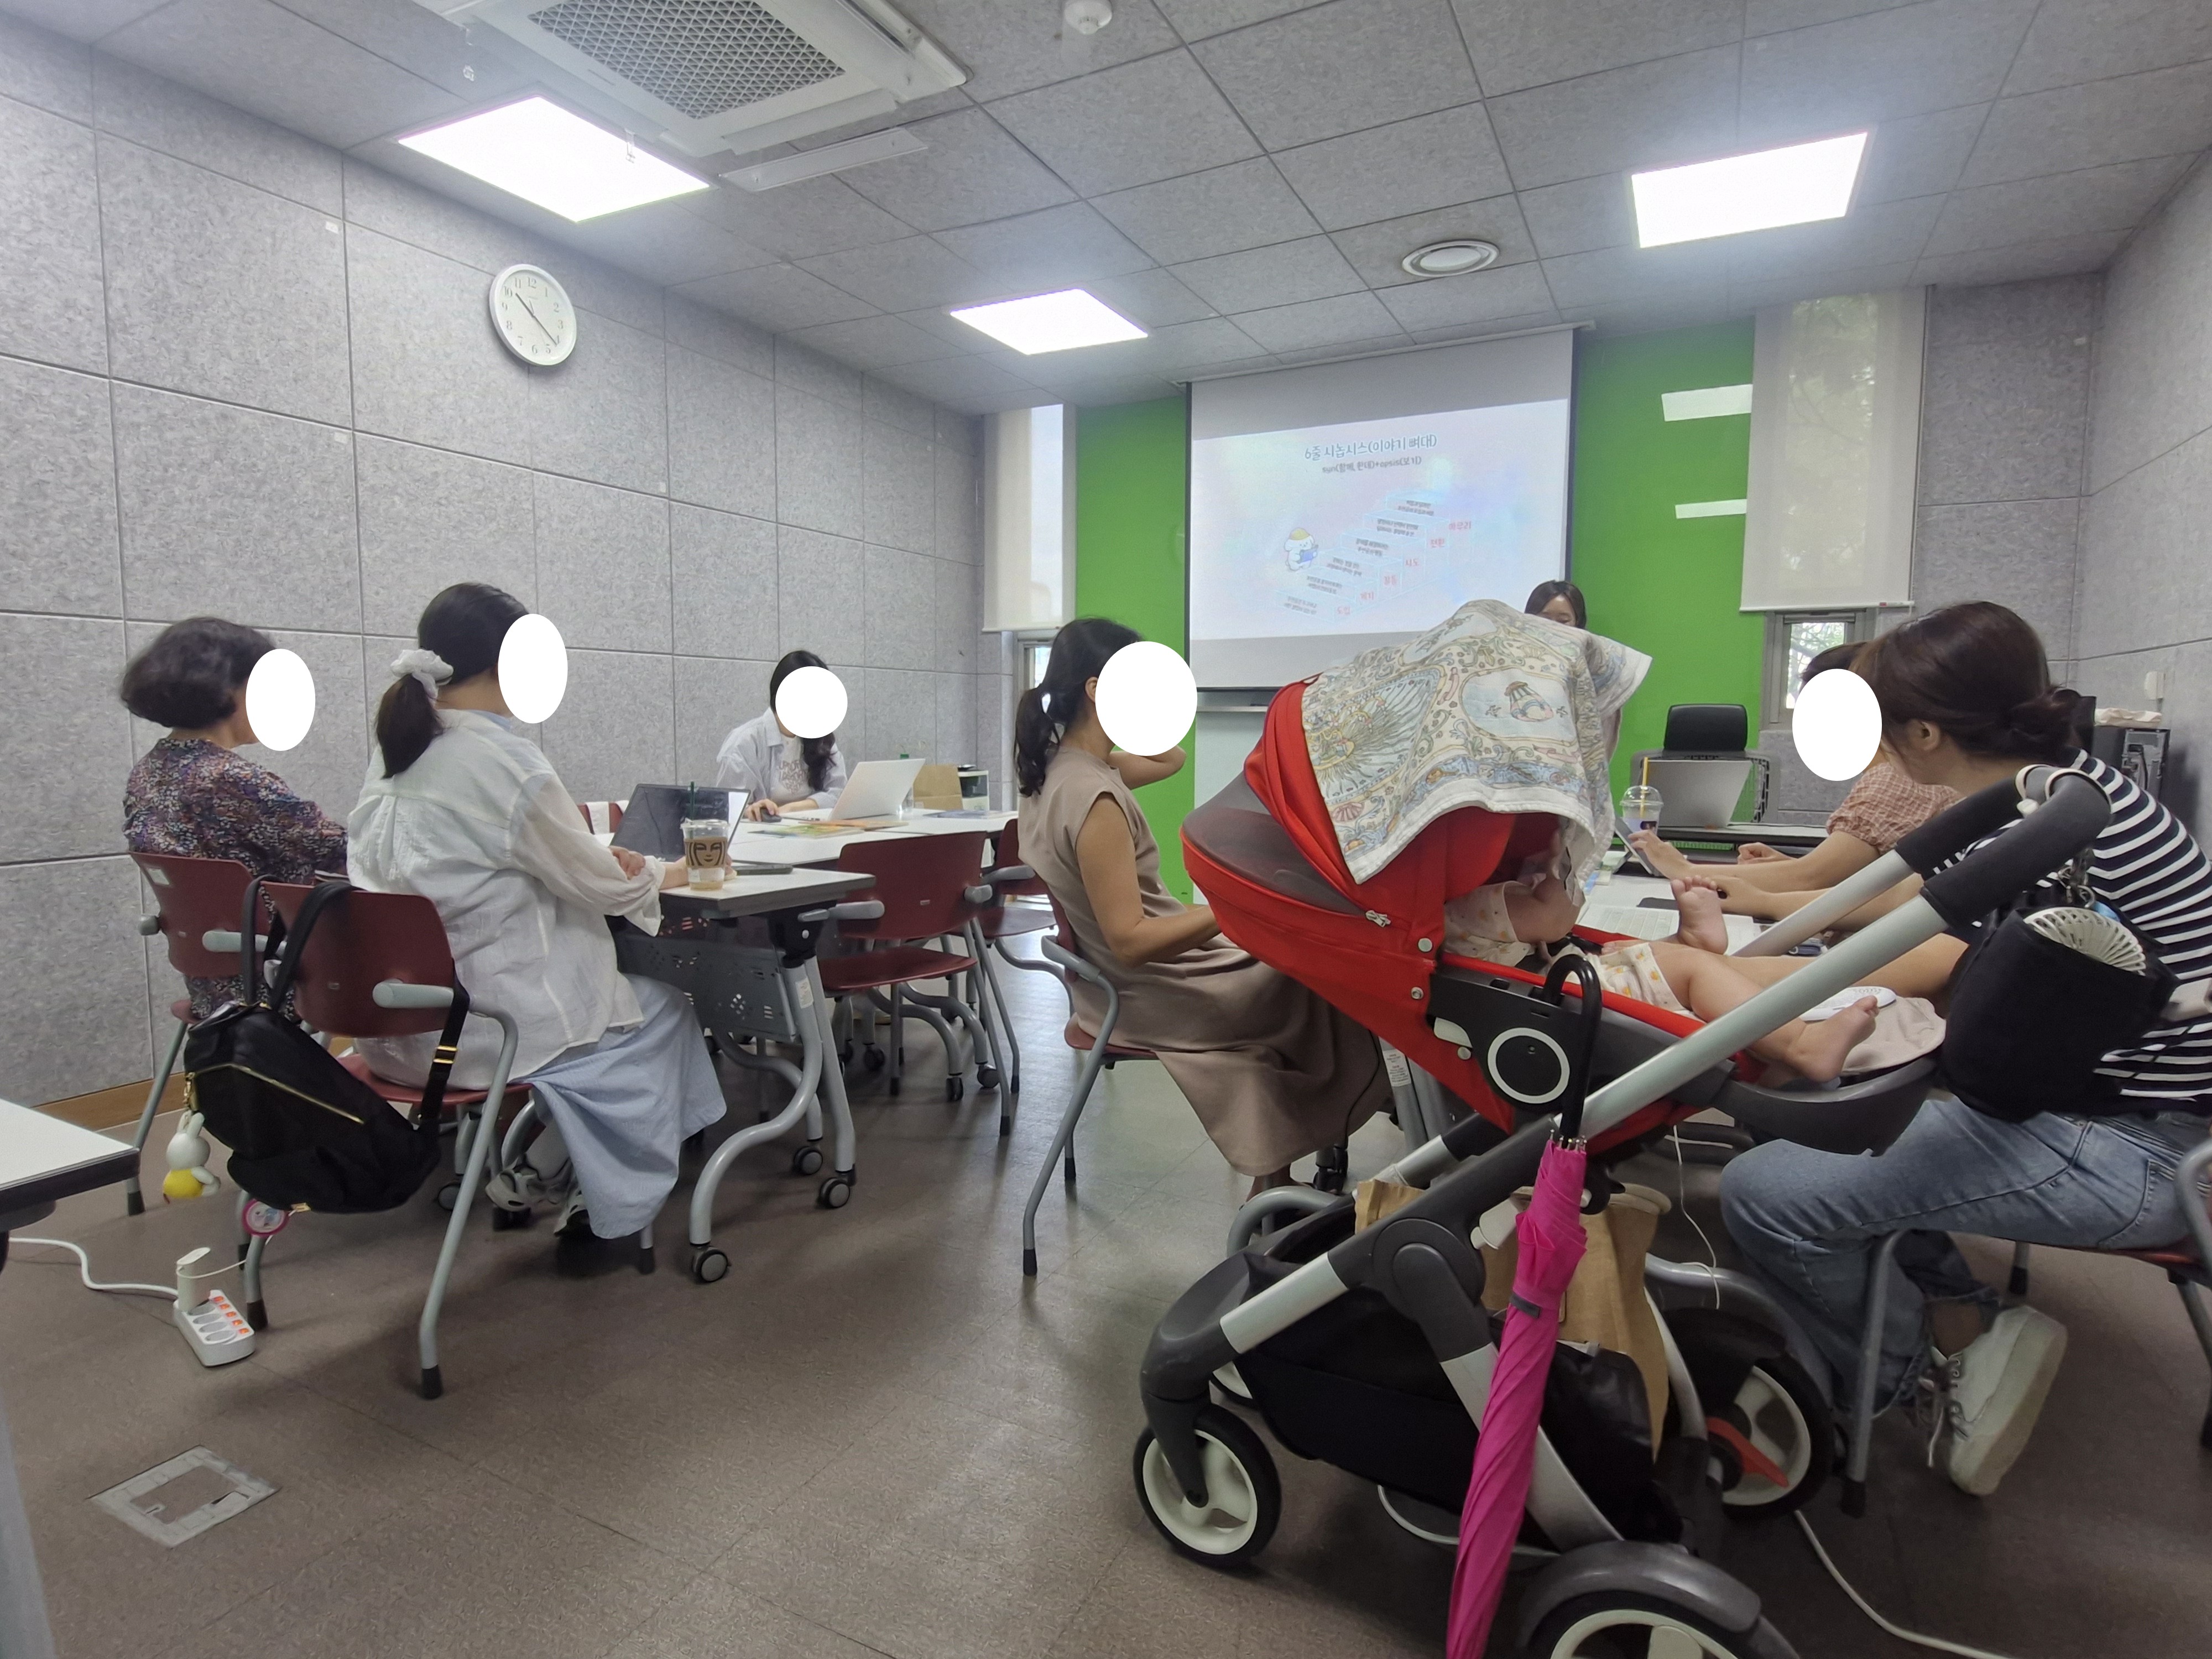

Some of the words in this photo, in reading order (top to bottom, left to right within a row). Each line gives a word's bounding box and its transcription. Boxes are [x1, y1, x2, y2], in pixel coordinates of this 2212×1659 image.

[514, 278, 521, 289] 11
[527, 277, 537, 288] 12
[504, 286, 512, 297] 10
[544, 287, 548, 298] 1
[502, 302, 508, 310] 9
[553, 302, 559, 312] 2
[507, 320, 512, 330] 8
[558, 320, 564, 330] 3
[518, 336, 523, 346] 7
[531, 345, 538, 354] 6
[545, 344, 551, 354] 5
[1305, 445, 1321, 461] 6줄
[1324, 437, 1406, 458] 시놉시스(이야기
[1408, 434, 1437, 450] 뼈대)
